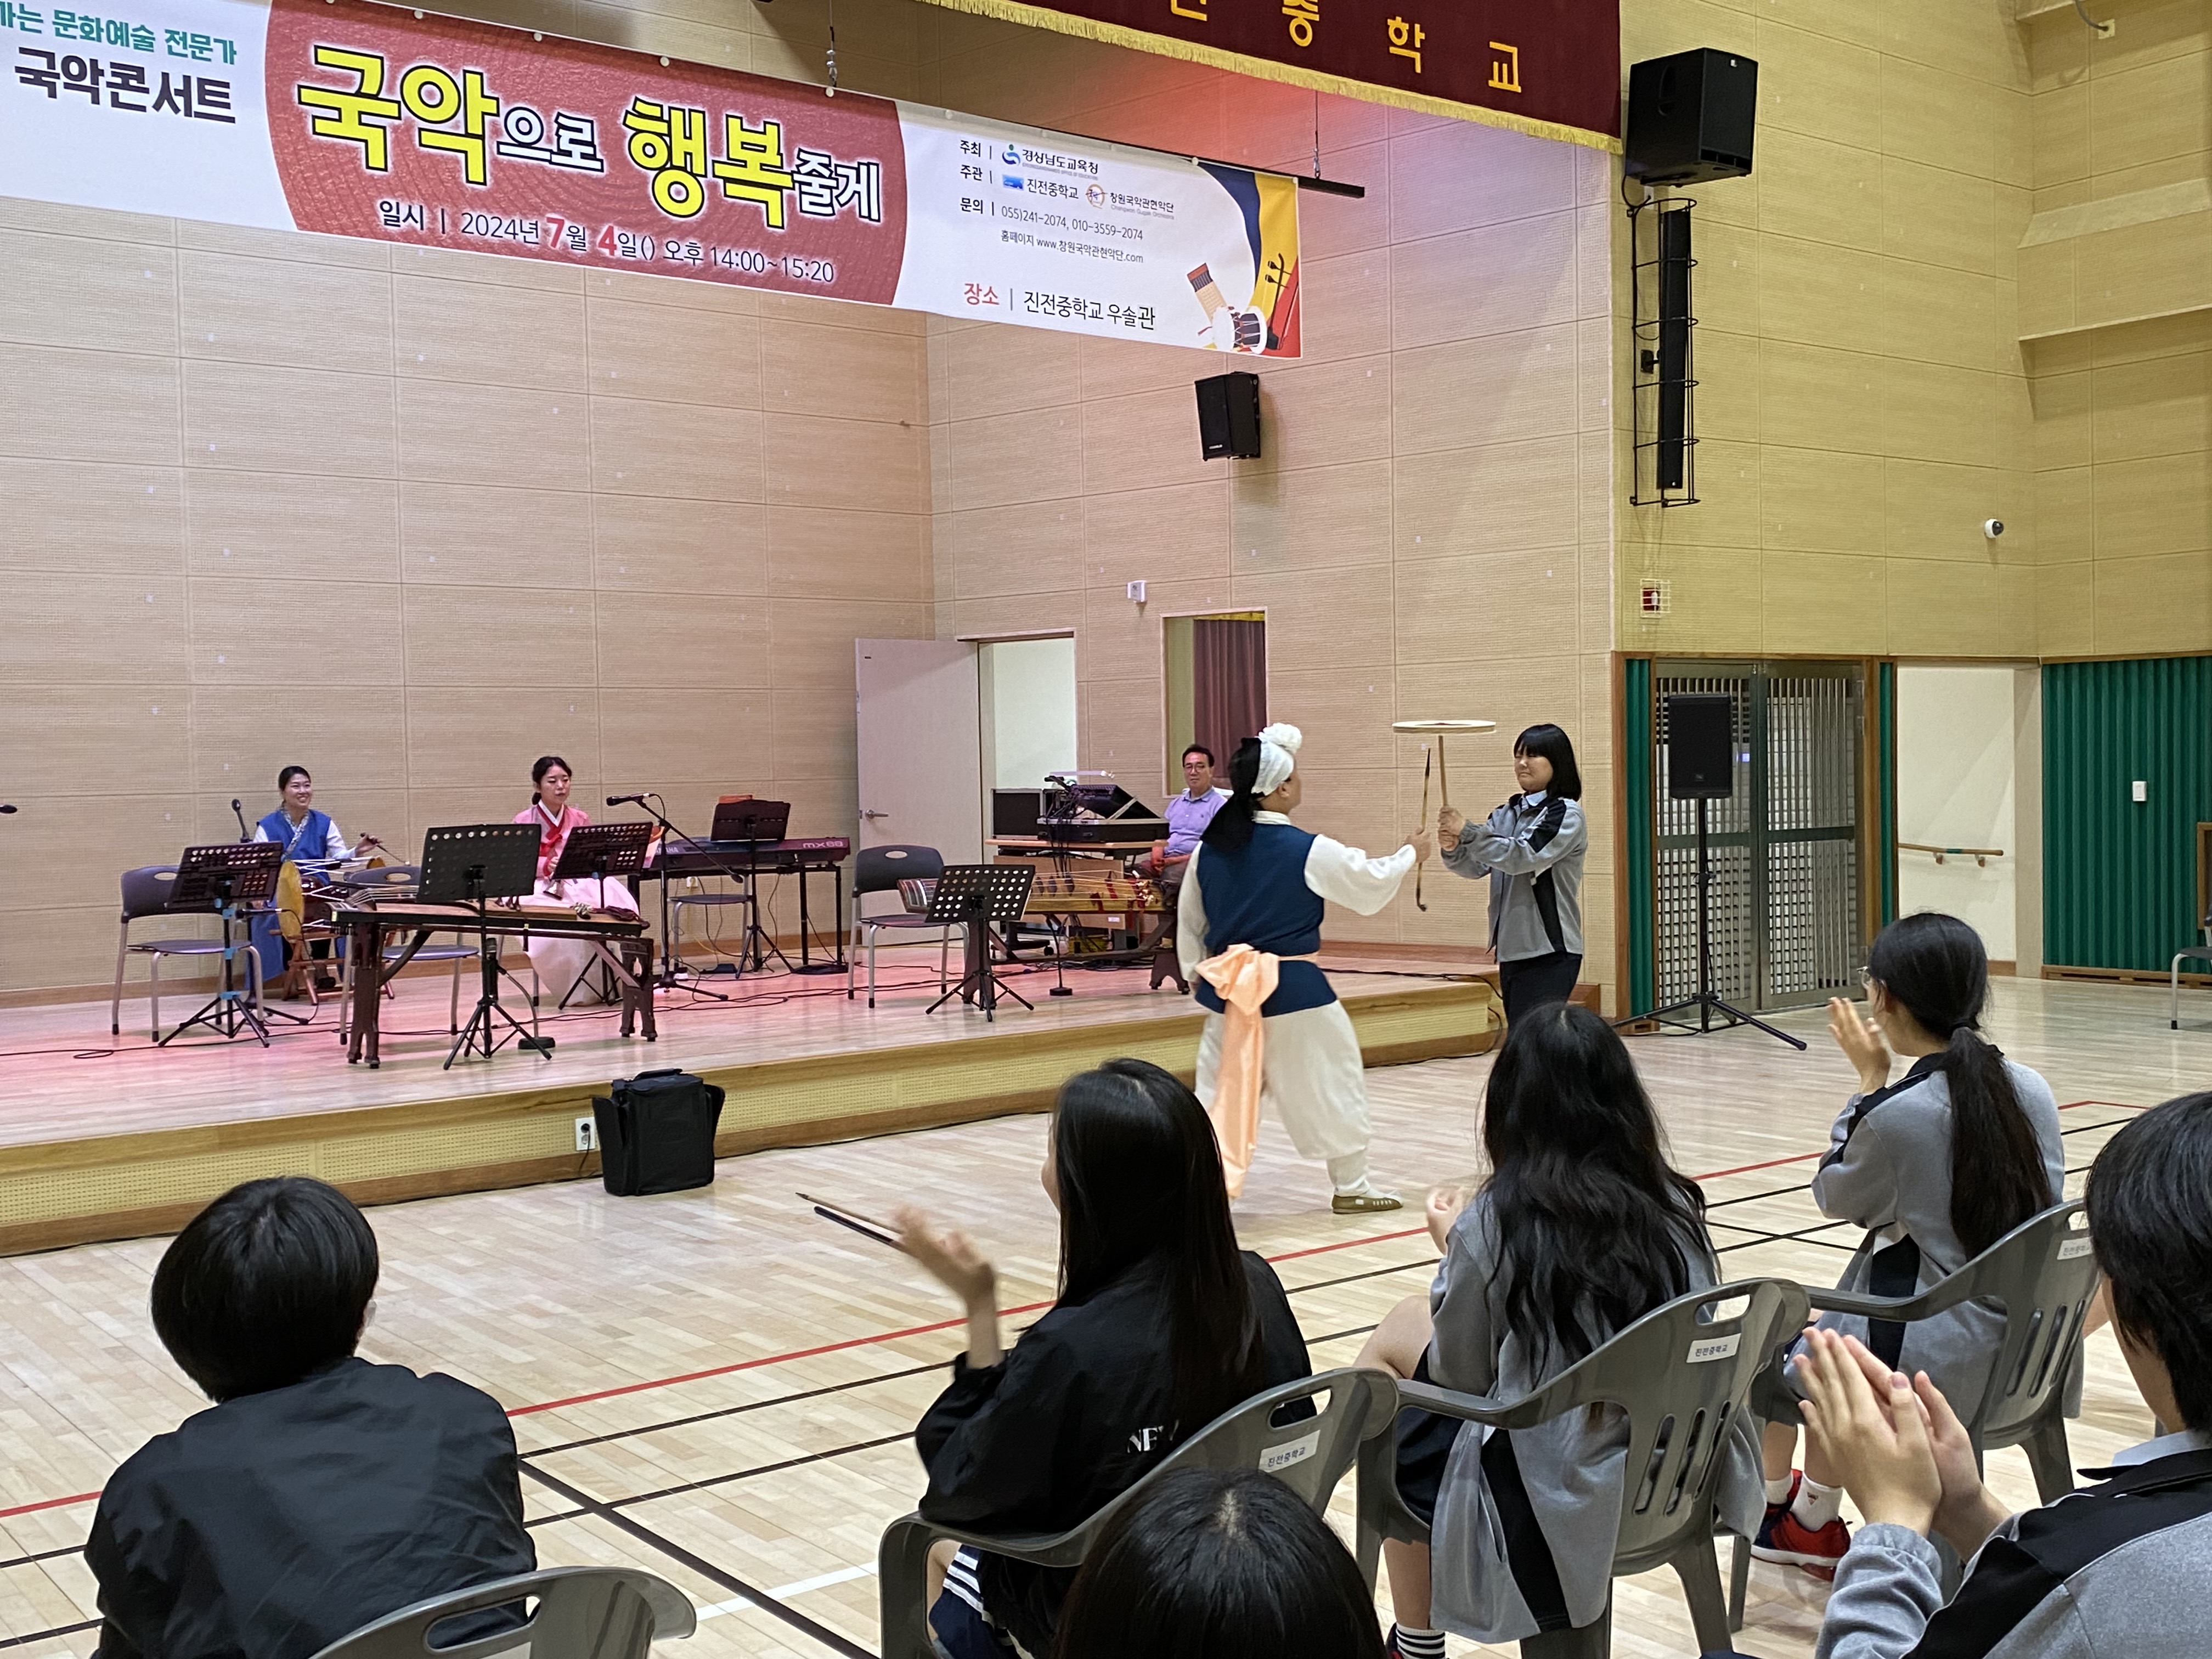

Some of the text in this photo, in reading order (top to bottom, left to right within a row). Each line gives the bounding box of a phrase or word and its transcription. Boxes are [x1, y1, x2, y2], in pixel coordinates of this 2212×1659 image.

[53, 9, 155, 53] 문화예술
[165, 29, 237, 65] 전문가
[14, 47, 236, 124] 국악콘서트
[297, 44, 604, 187] 국악으로
[960, 140, 981, 157] 주최
[1022, 149, 1098, 174] 경상남도교육청
[960, 165, 983, 182] 주관
[1027, 179, 1079, 199] 진전중학교
[1110, 193, 1174, 213] 창원국악관현악단
[380, 201, 424, 230] 일시
[461, 212, 539, 245] 2024년
[546, 217, 587, 251] 7월
[663, 240, 704, 266] 오후
[710, 247, 833, 282] 14:00~15:20
[960, 198, 1143, 240] 문의 055)241-2074, 010-3559-2074
[1001, 229, 1143, 263] 홈페이지 www.창원국악관현악단.com
[964, 283, 1155, 330] 장소 진전중학교 우솔관
[1268, 1447, 1305, 1468] 진전중학교
